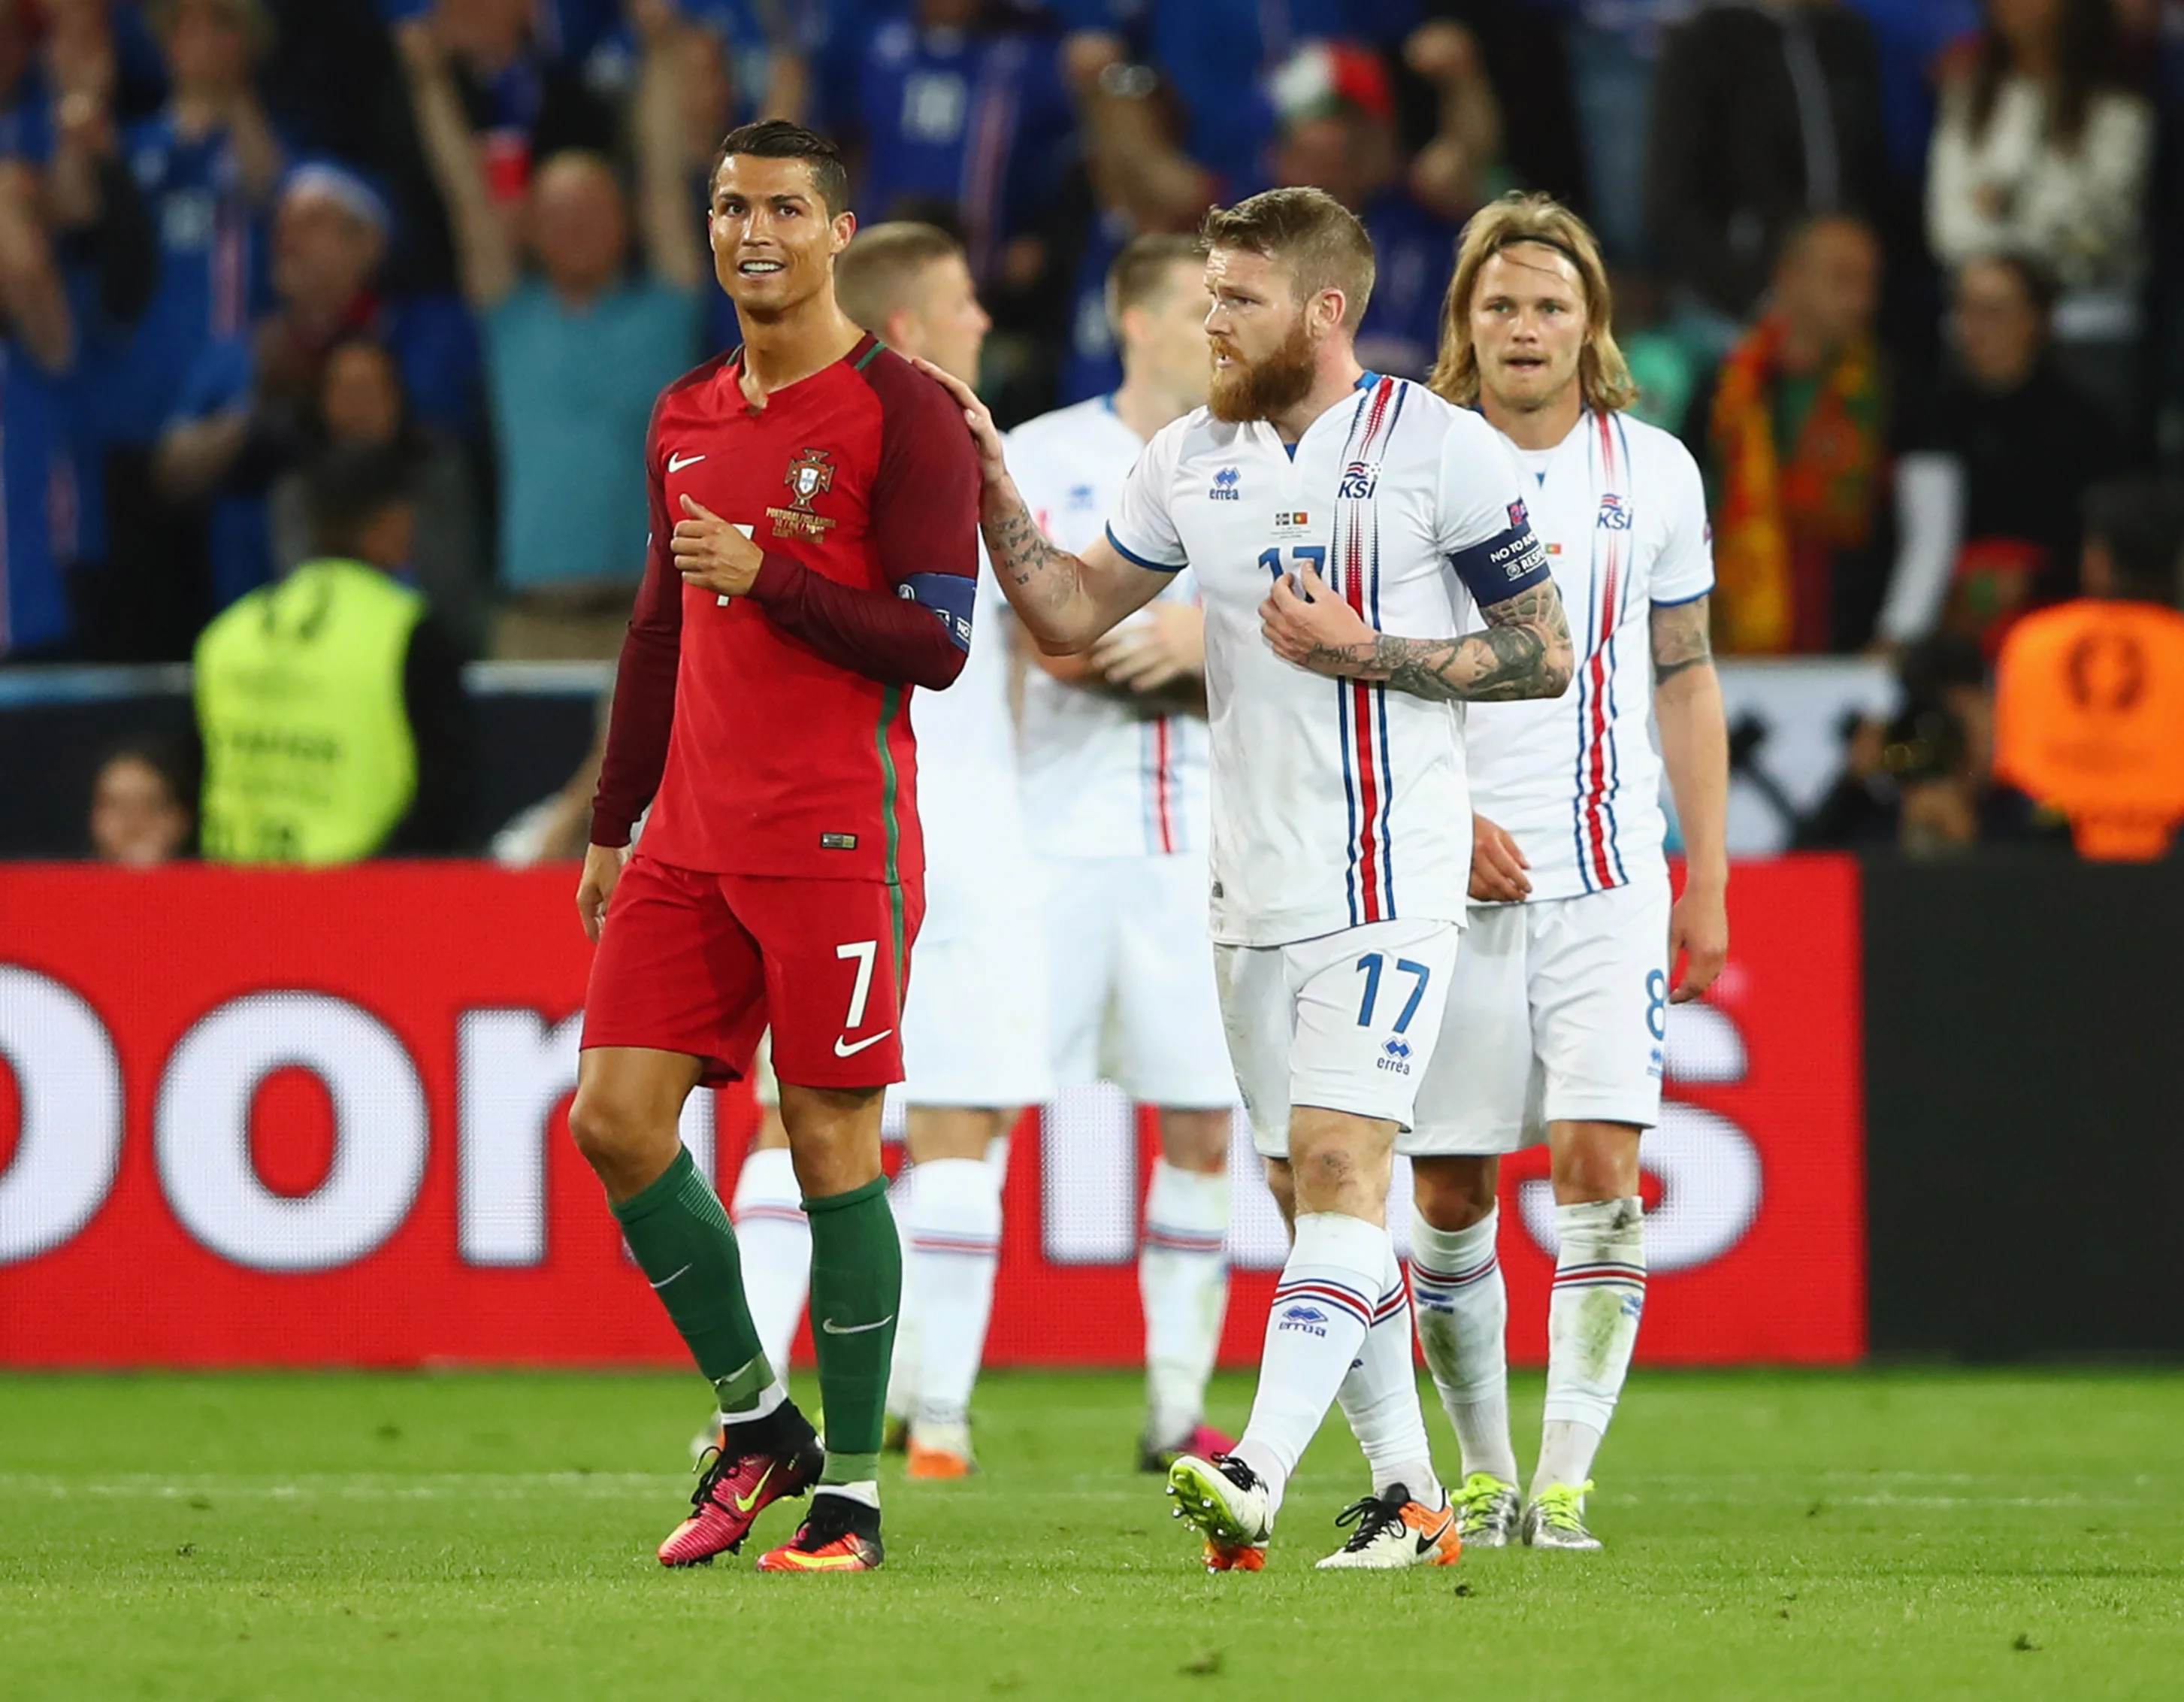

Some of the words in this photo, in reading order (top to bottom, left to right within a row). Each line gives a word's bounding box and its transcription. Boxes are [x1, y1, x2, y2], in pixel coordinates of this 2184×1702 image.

[1490, 547, 1510, 564] NO
[1508, 540, 1524, 553] TO
[836, 940, 878, 1028] 7
[1356, 952, 1429, 1034] 17
[1646, 968, 1665, 1041] 8
